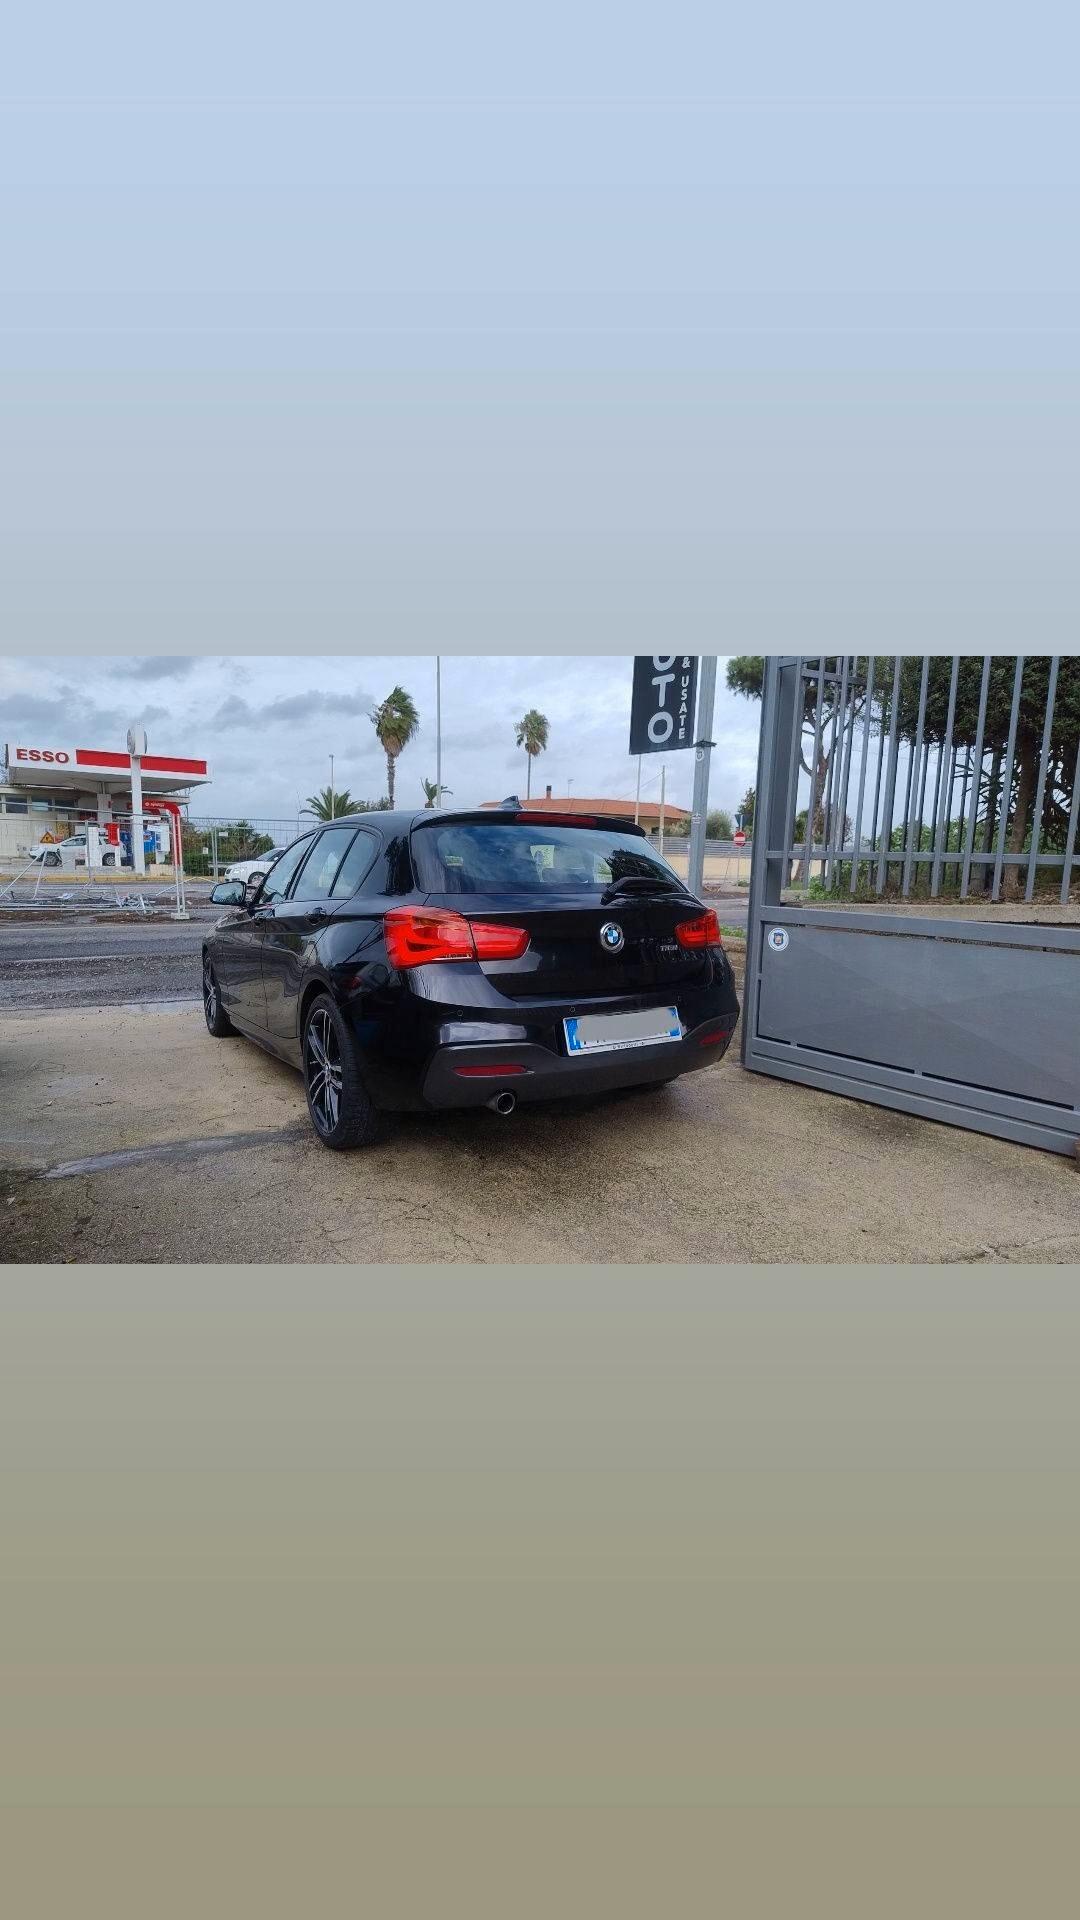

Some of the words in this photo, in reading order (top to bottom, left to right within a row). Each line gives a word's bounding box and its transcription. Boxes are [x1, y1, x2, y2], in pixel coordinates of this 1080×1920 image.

[681, 656, 691, 669] &
[678, 675, 690, 740] USATE
[16, 748, 70, 764] ESSO
